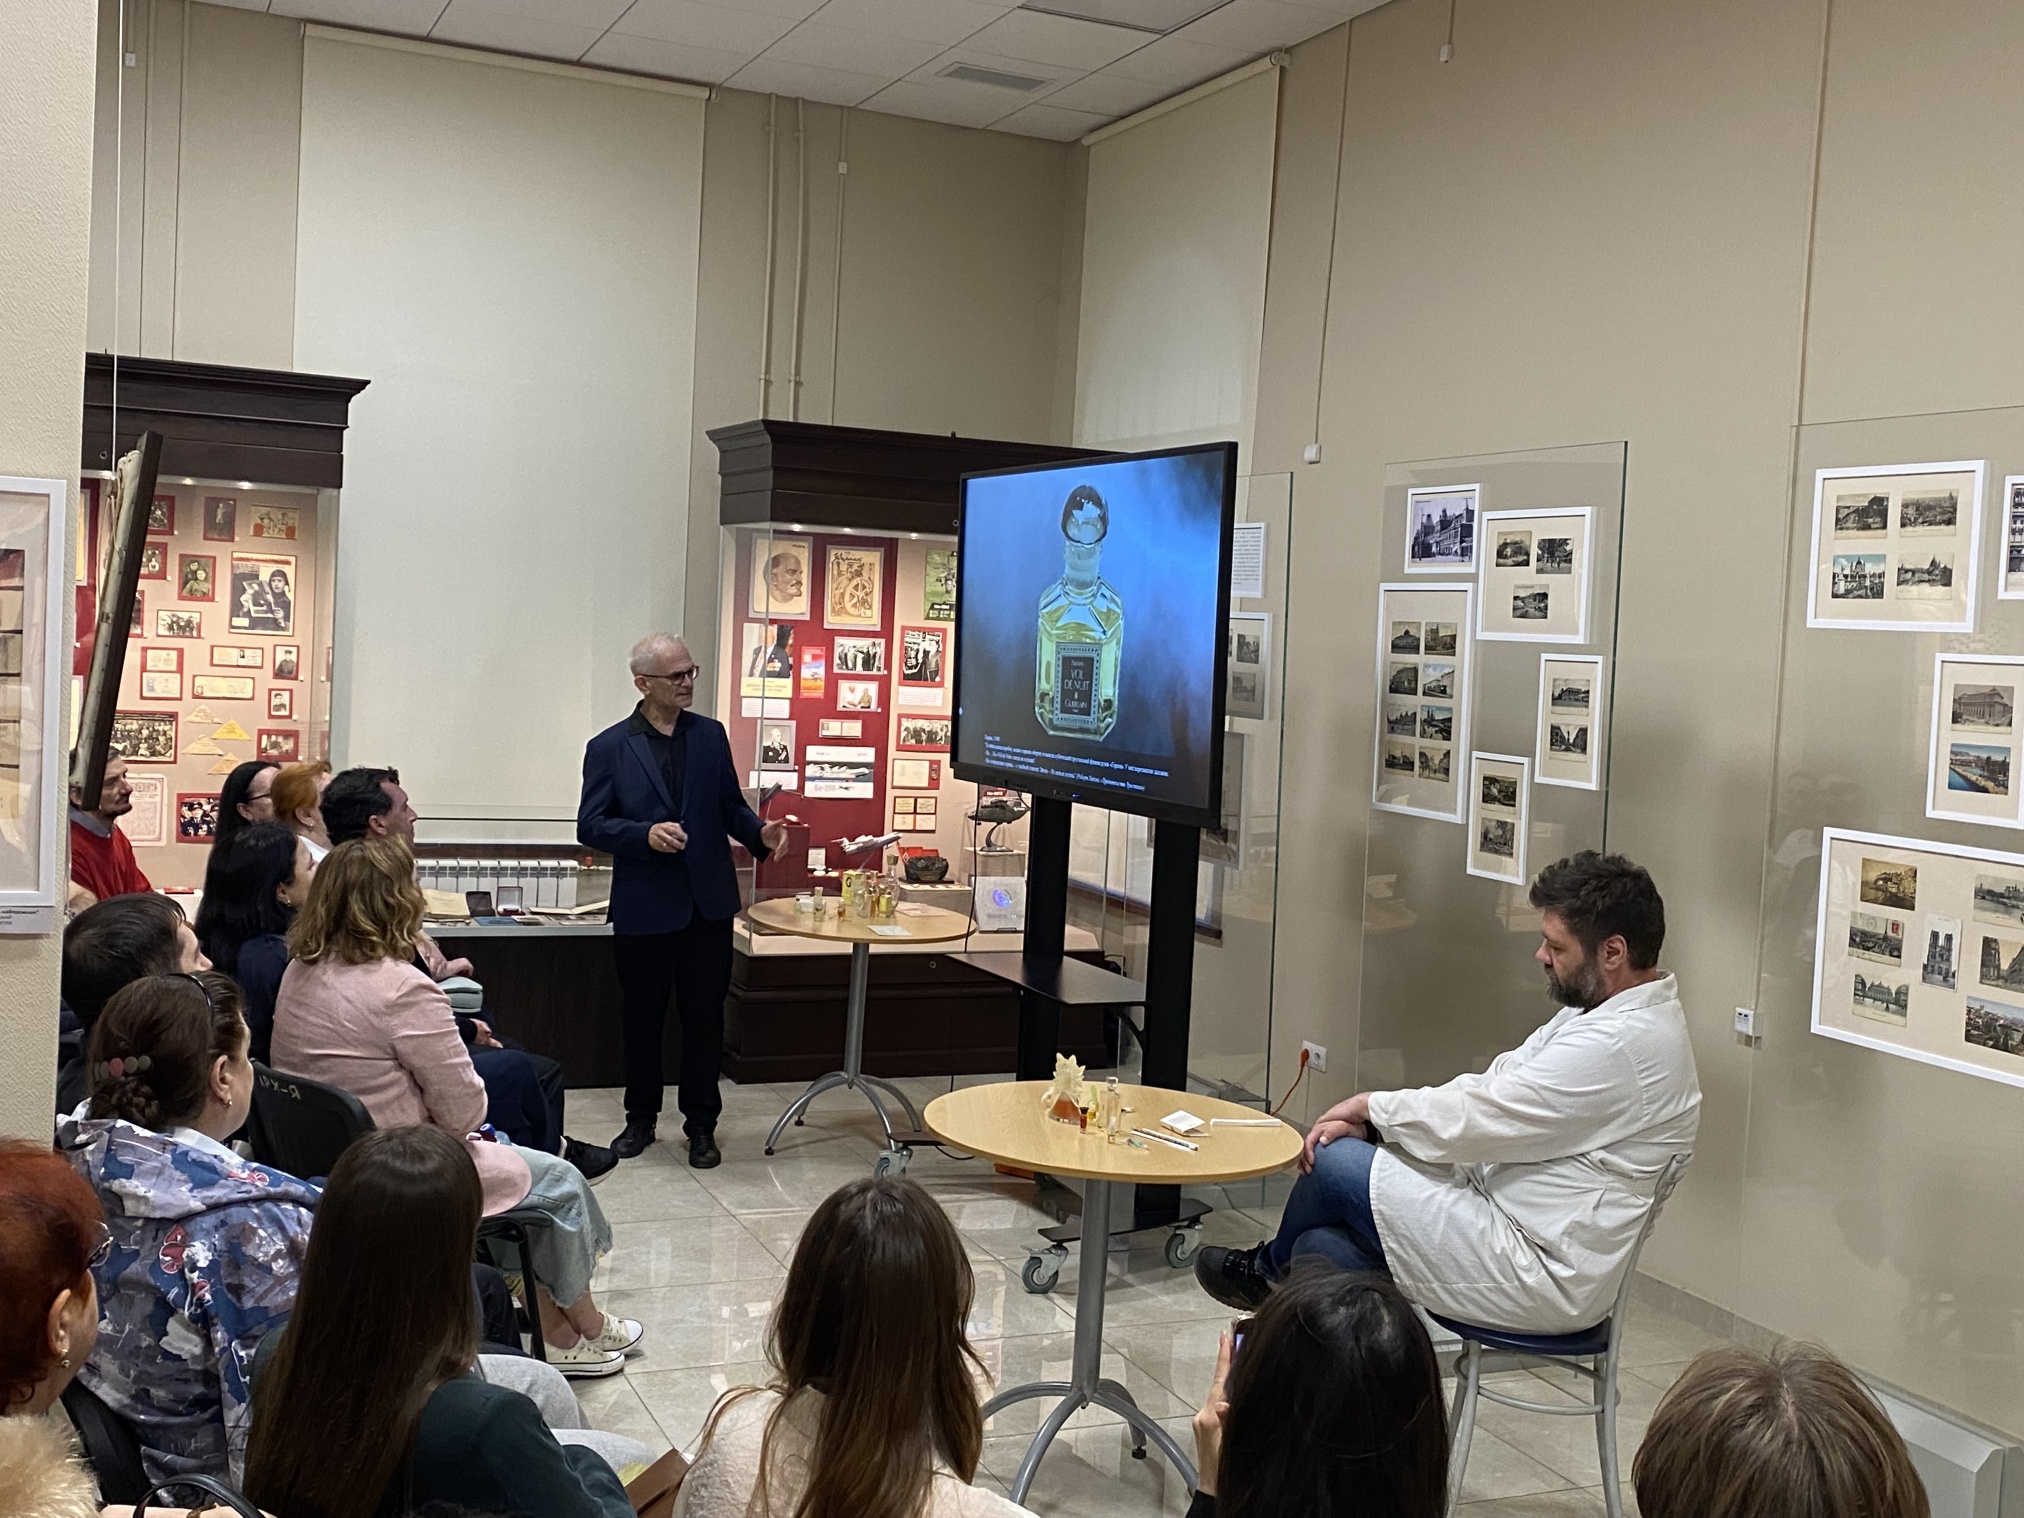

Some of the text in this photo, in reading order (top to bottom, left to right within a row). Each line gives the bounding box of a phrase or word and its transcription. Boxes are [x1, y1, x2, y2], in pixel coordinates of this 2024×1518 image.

[1070, 667, 1084, 680] VOL
[1064, 679, 1090, 691] DE NUIT
